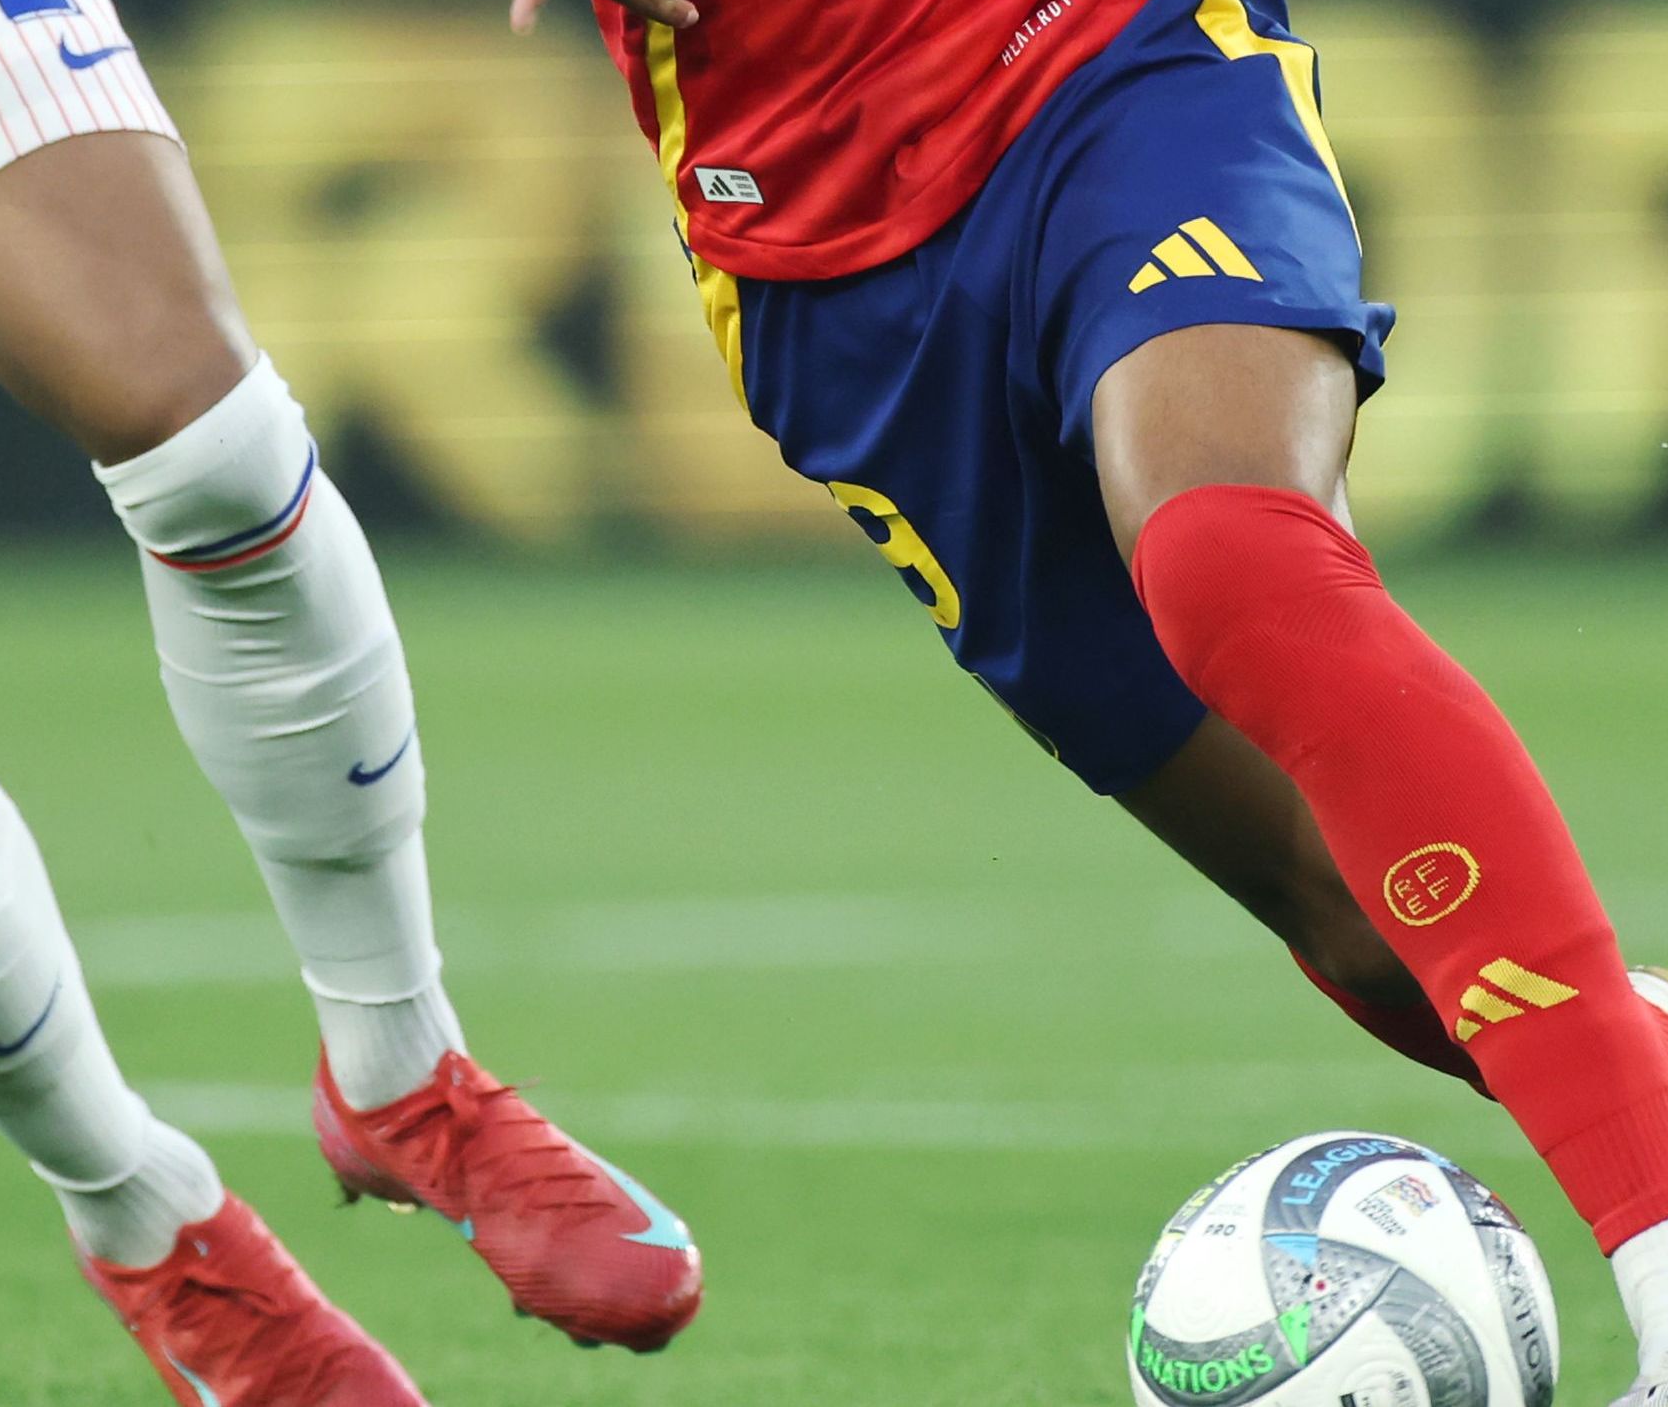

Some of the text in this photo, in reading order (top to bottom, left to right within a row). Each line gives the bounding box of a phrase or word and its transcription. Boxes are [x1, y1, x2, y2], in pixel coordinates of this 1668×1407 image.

[1281, 1140, 1399, 1205] LEAGUE
[1204, 1223, 1237, 1237] PRO
[1142, 1340, 1276, 1393] NATIONS
